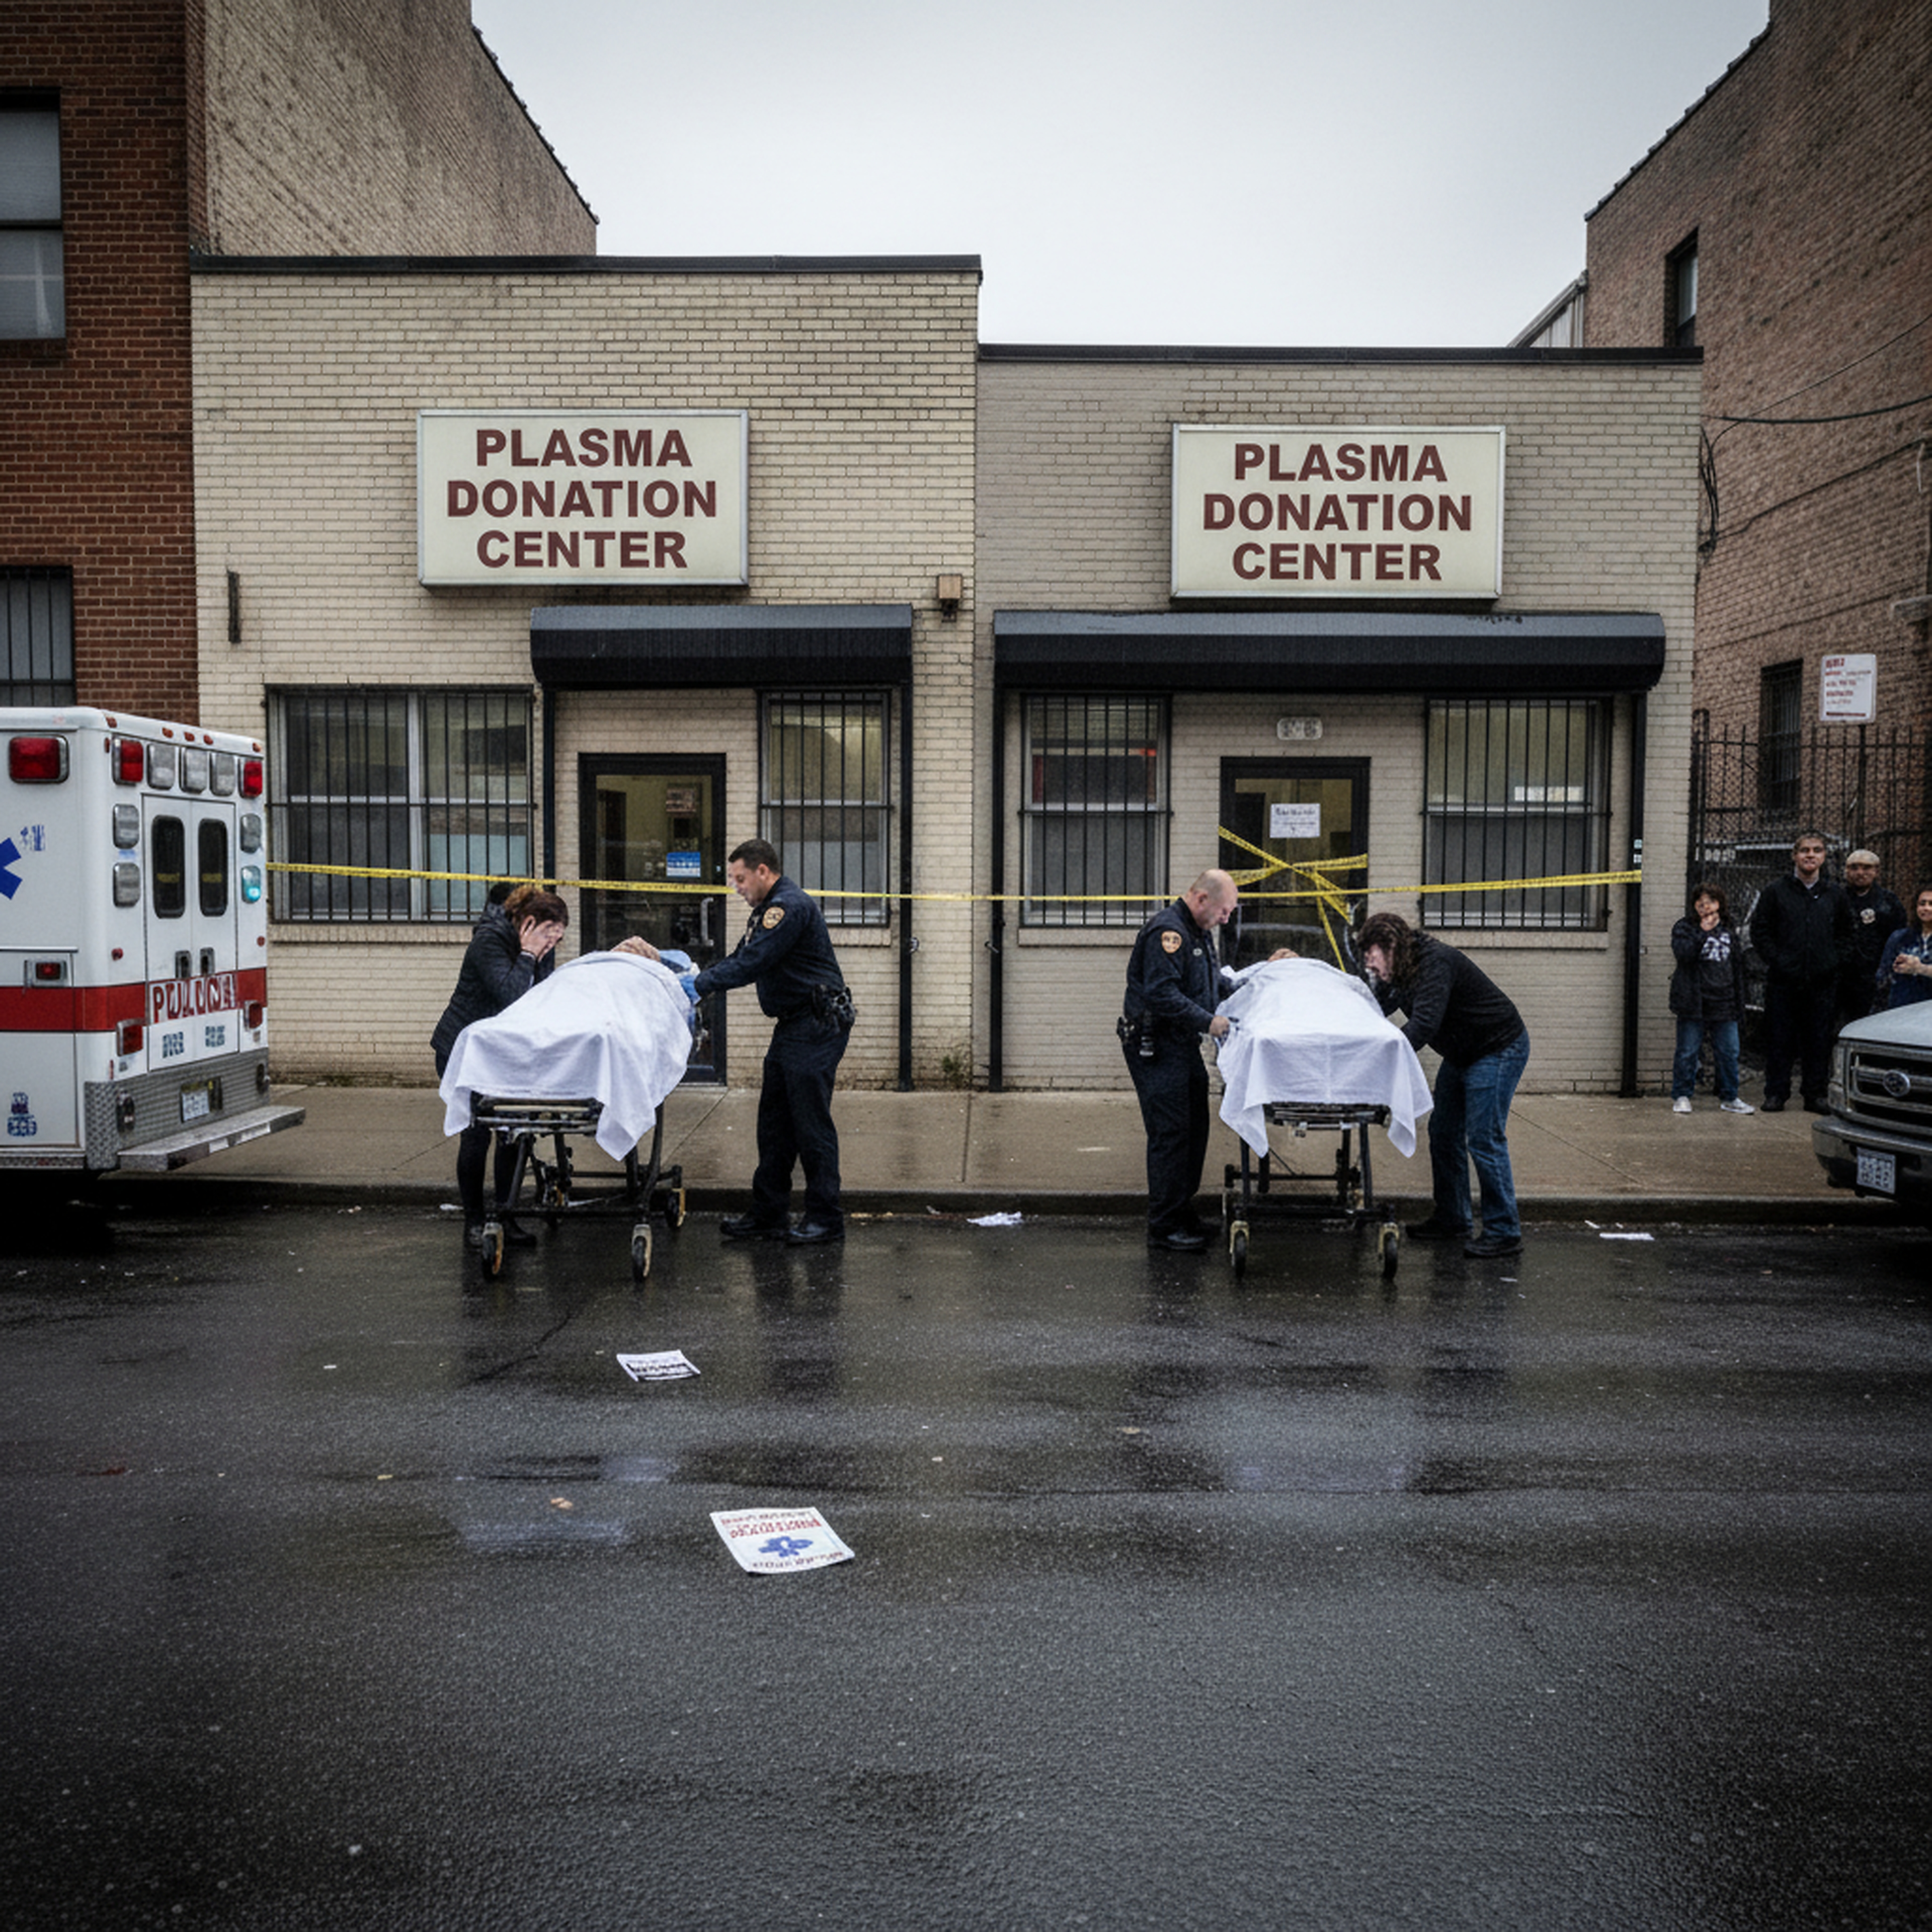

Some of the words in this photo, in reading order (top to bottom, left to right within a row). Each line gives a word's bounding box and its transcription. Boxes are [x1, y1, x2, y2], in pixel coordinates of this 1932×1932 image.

[476, 428, 693, 467] PLASMA
[1235, 443, 1447, 482] PLASMA
[447, 479, 716, 518] DONATION
[1203, 492, 1472, 532] DONATION
[477, 530, 688, 569] CENTER
[1232, 542, 1442, 581] CENTER
